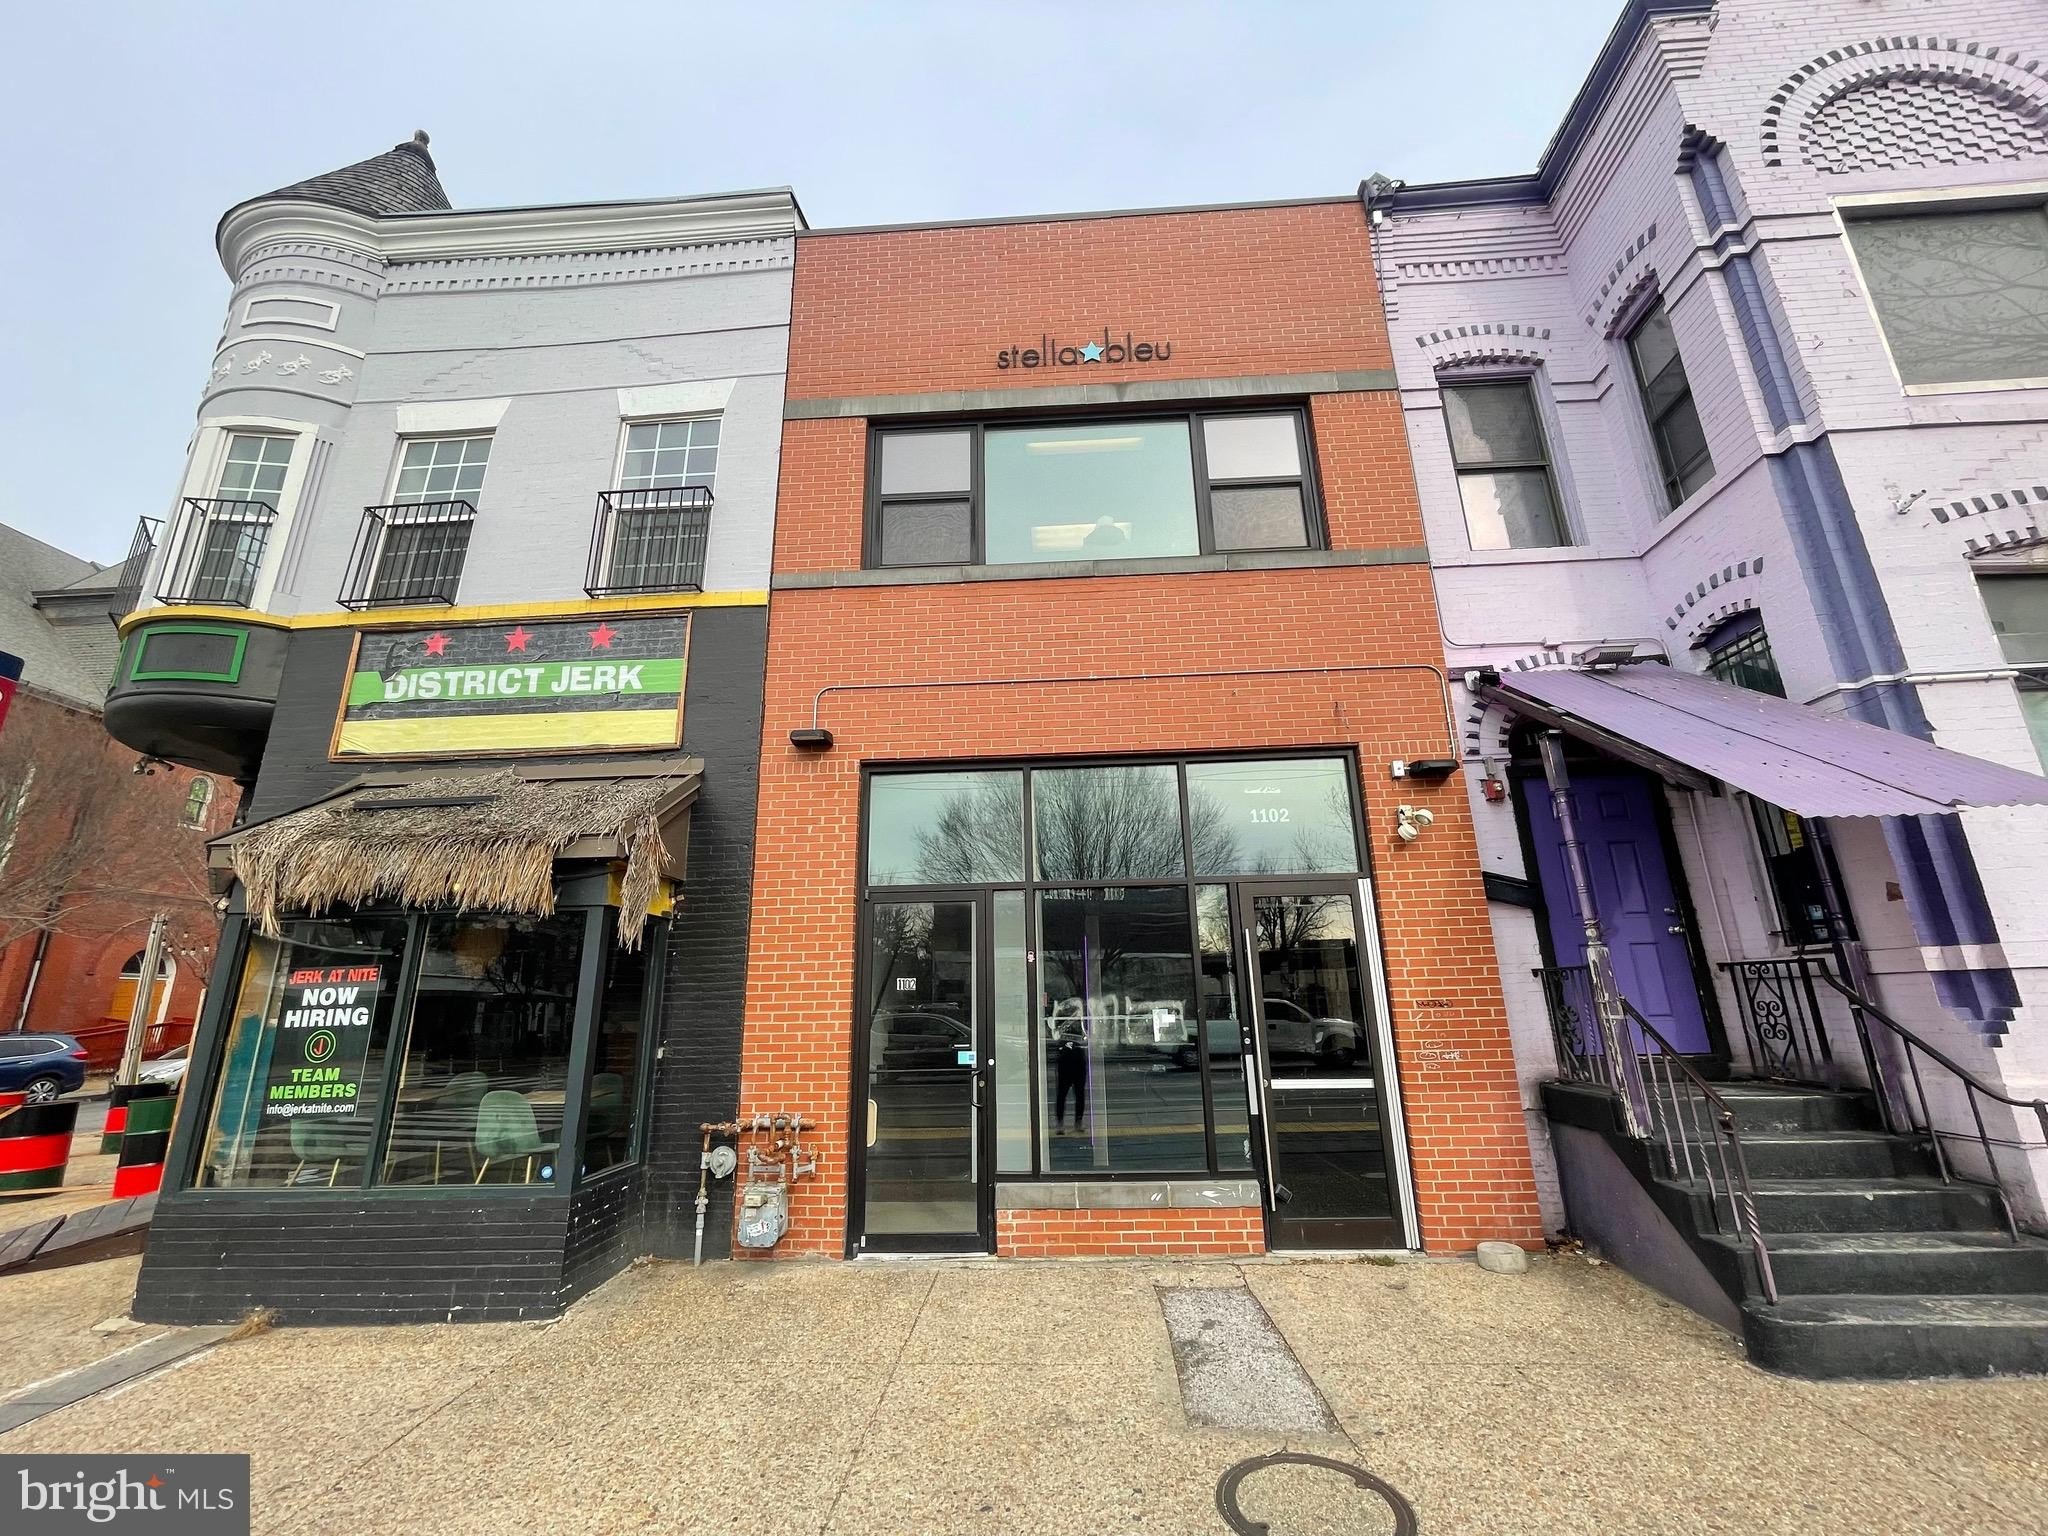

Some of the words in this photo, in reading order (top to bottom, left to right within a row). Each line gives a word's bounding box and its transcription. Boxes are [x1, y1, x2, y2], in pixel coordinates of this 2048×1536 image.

[997, 333, 1077, 369] stella
[1104, 326, 1171, 364] bleu
[384, 667, 545, 699] DISTRICT
[551, 664, 645, 692] JERK
[1249, 808, 1290, 823] 1102
[289, 970, 324, 985] JERK
[327, 969, 345, 982] AT
[347, 967, 378, 982] NITE
[896, 977, 917, 991] 1102
[301, 986, 360, 1006] NOW
[284, 1007, 369, 1028] HIRING
[291, 1067, 341, 1082] TEAM
[269, 1083, 357, 1100] MEMBERS
[266, 1103, 355, 1117] info@jerkatnite.com
